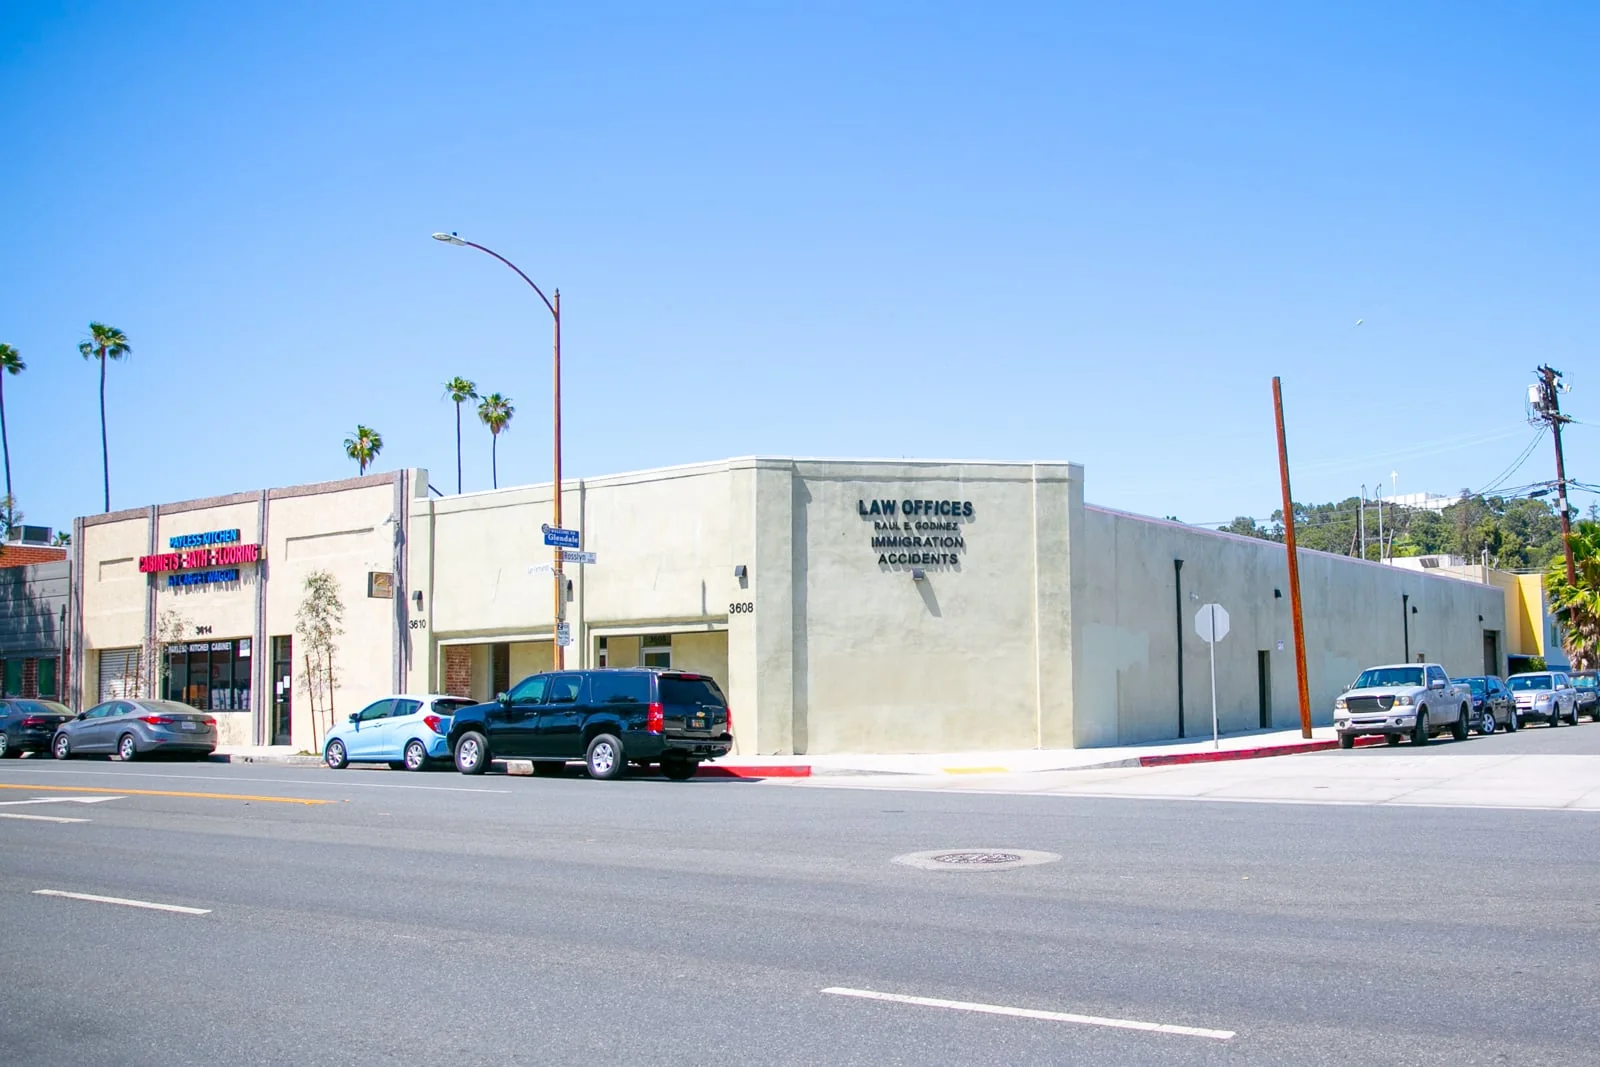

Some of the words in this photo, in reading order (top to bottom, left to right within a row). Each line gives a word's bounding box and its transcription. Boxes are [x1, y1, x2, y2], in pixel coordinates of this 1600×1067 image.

[859, 500, 896, 515] LAW
[902, 500, 973, 516] OFFICES
[874, 522, 900, 531] RAUL
[170, 533, 202, 549] PAYLESS
[202, 529, 238, 545] KITCHEN
[548, 533, 578, 543] Glendale
[871, 537, 964, 548] IMMIGRATION
[139, 553, 179, 573] CABINETS
[216, 544, 259, 565] FLOORING
[878, 554, 958, 565] ACCIDENTS
[207, 569, 237, 583] WAGON
[729, 602, 754, 614] 3608
[409, 619, 426, 629] 3610
